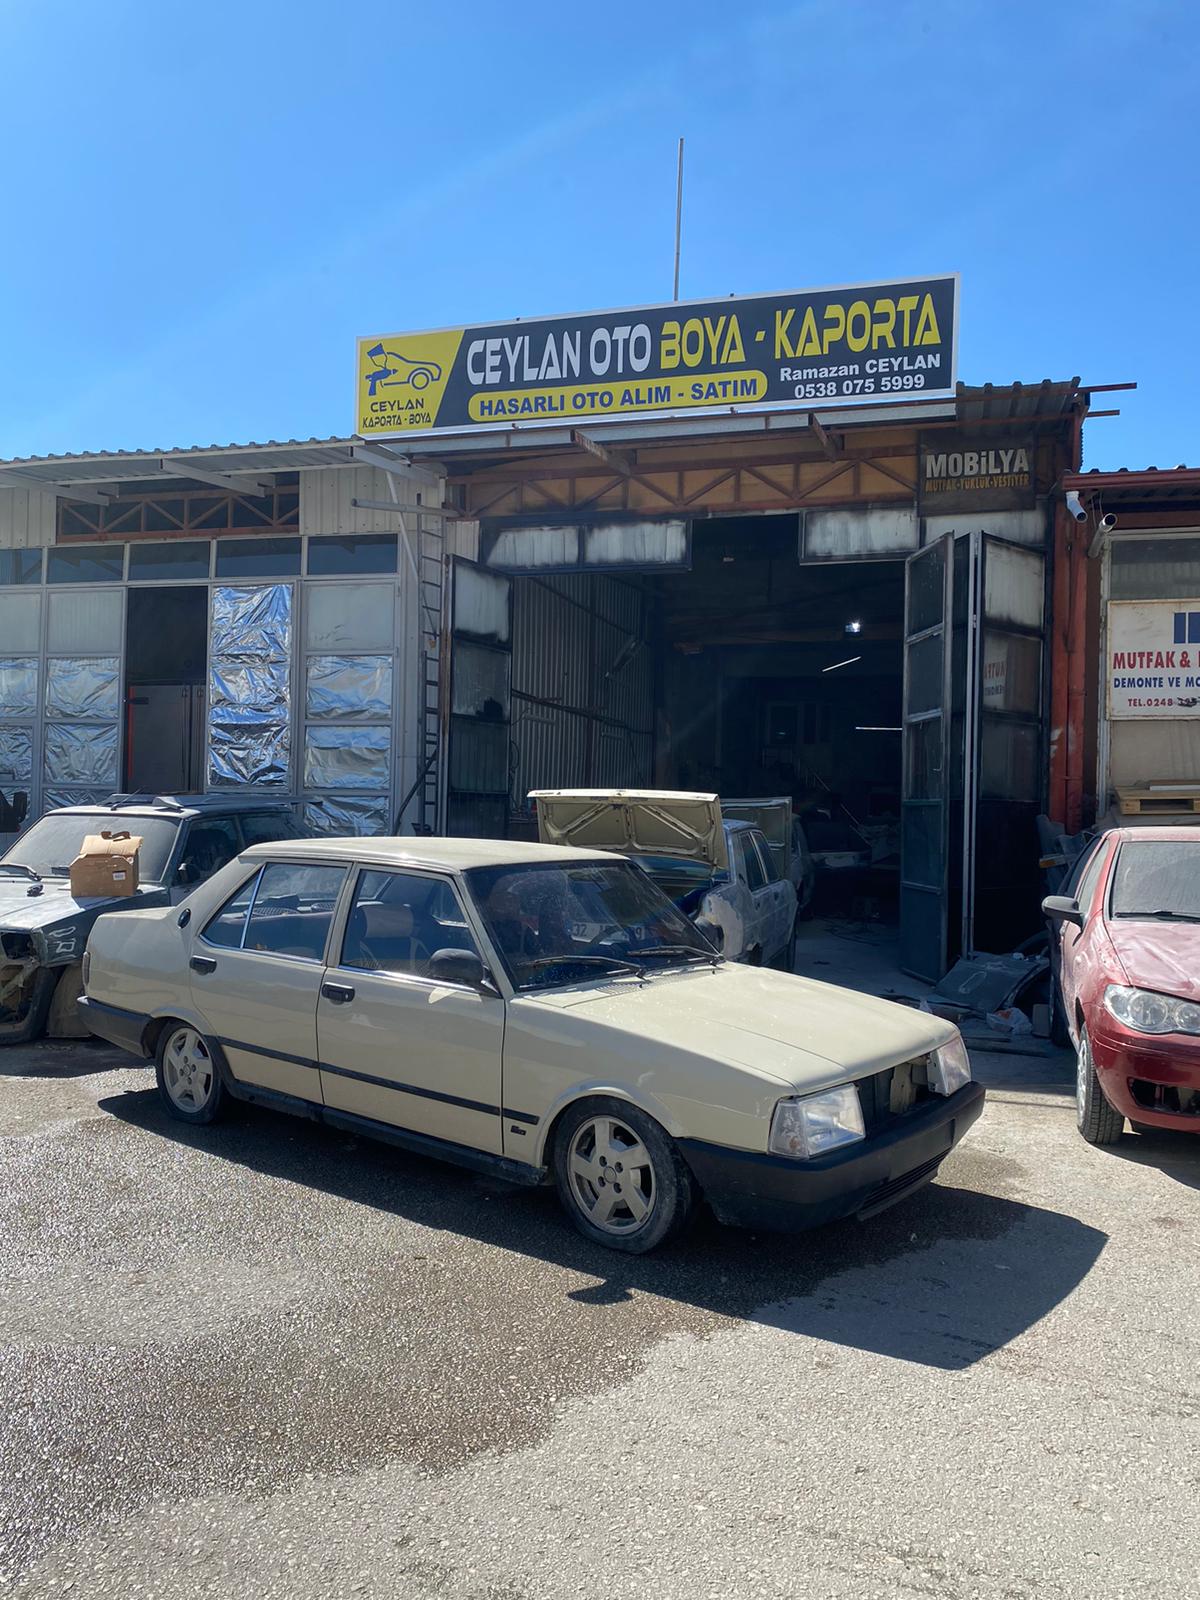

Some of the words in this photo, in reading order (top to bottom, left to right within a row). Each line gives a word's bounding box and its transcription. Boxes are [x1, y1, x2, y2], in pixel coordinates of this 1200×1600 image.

[466, 330, 582, 386] CEYLAN
[589, 323, 652, 377] OTO
[660, 314, 747, 370] BOYA
[774, 293, 942, 360] KAPORTA
[780, 363, 860, 382] Ramazan
[865, 353, 941, 375] CEYLAN
[794, 383, 837, 399] 0538
[842, 379, 875, 396] 075
[880, 373, 925, 391] 5999
[370, 398, 424, 413] CEYLAN
[479, 394, 565, 417] HASARLI
[572, 391, 614, 410] OTO
[620, 385, 671, 406] ALIM
[690, 378, 758, 401] SATIM
[362, 414, 403, 429] KAPORTA
[408, 412, 432, 425] BOYA
[1112, 651, 1176, 670] MUTFAK
[1179, 650, 1191, 668] &
[1113, 677, 1164, 688] DEMONTE
[1168, 676, 1181, 688] VE
[1128, 697, 1174, 707] TEL.0248
